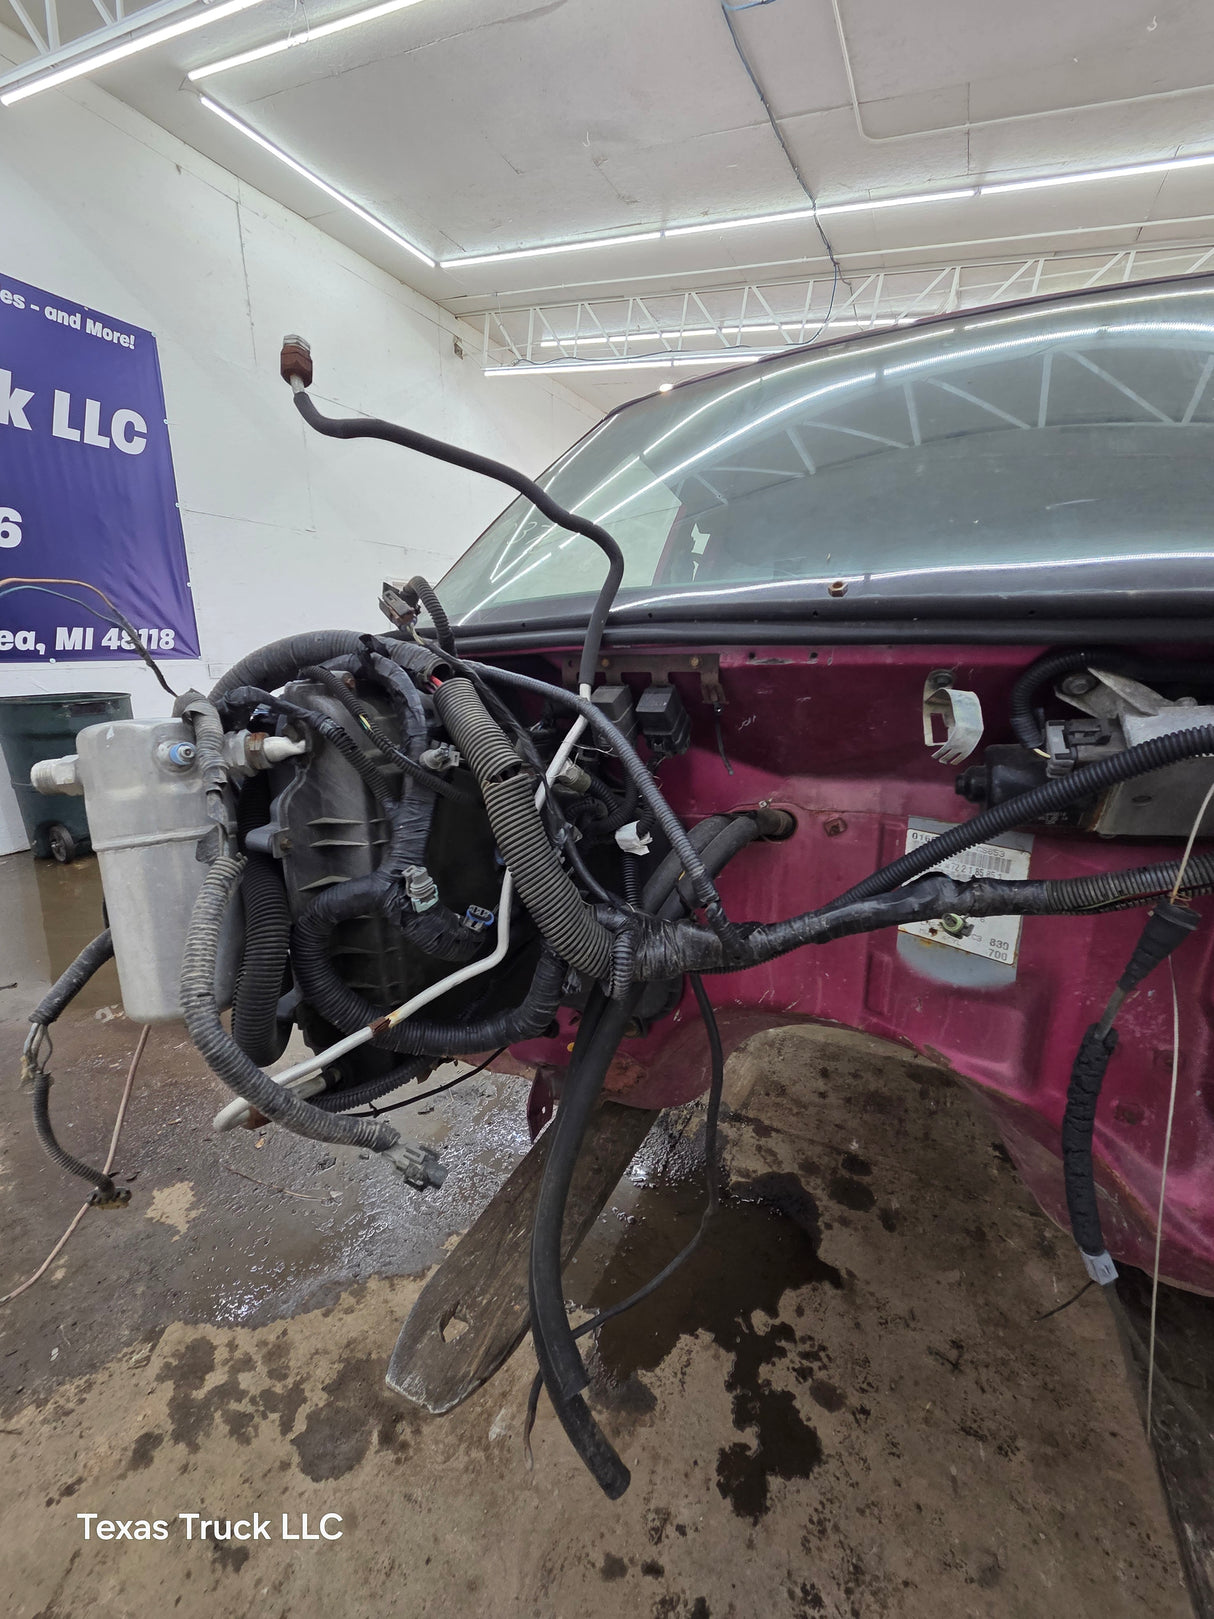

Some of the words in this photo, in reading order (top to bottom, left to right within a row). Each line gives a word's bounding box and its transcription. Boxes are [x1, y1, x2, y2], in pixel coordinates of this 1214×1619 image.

[44, 305, 82, 331] and
[85, 317, 136, 350] More!
[0, 368, 35, 431] k
[52, 389, 148, 455] LLC
[0, 506, 23, 549] 6
[0, 629, 46, 655] ea,
[55, 627, 94, 650] MI
[101, 627, 175, 651] 48118
